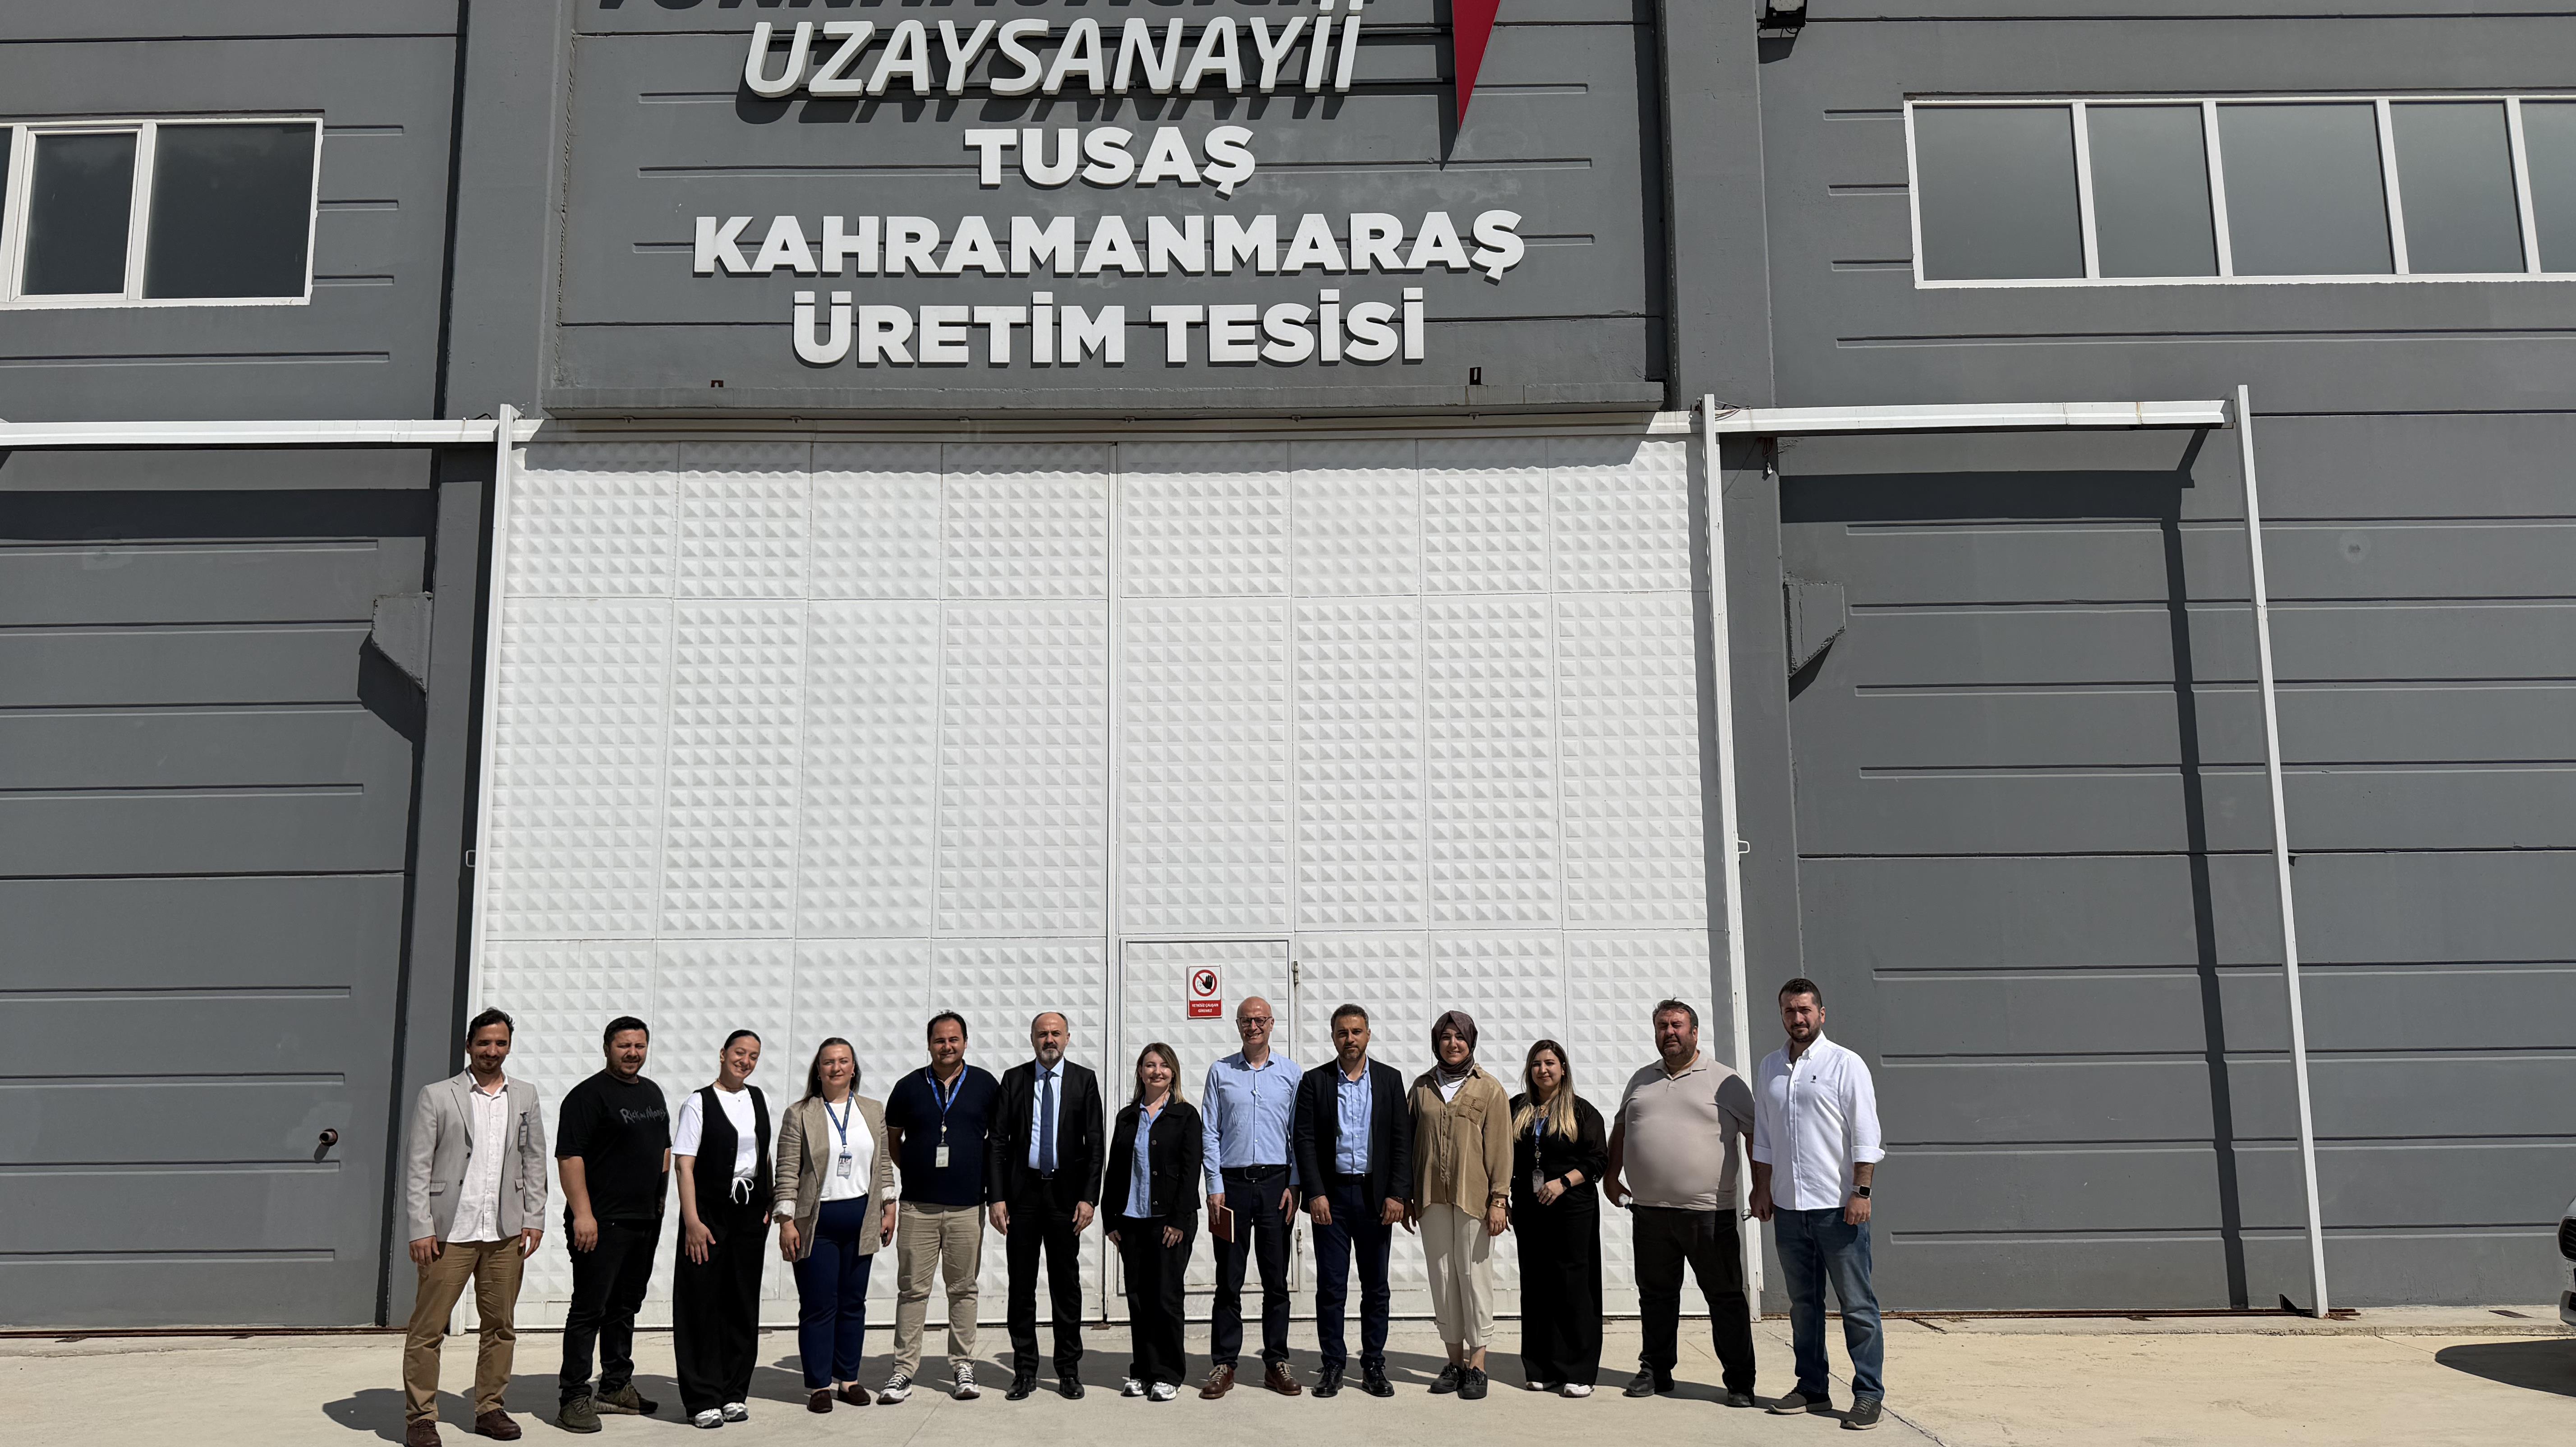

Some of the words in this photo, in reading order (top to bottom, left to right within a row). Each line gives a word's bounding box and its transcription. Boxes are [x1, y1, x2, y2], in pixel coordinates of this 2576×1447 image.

[964, 125, 1255, 196] TUSAŞ
[694, 210, 1525, 281] KAHRAMANMARAŞ
[793, 291, 1126, 364] ÜRETİM
[1150, 287, 1425, 363] TESİSİ
